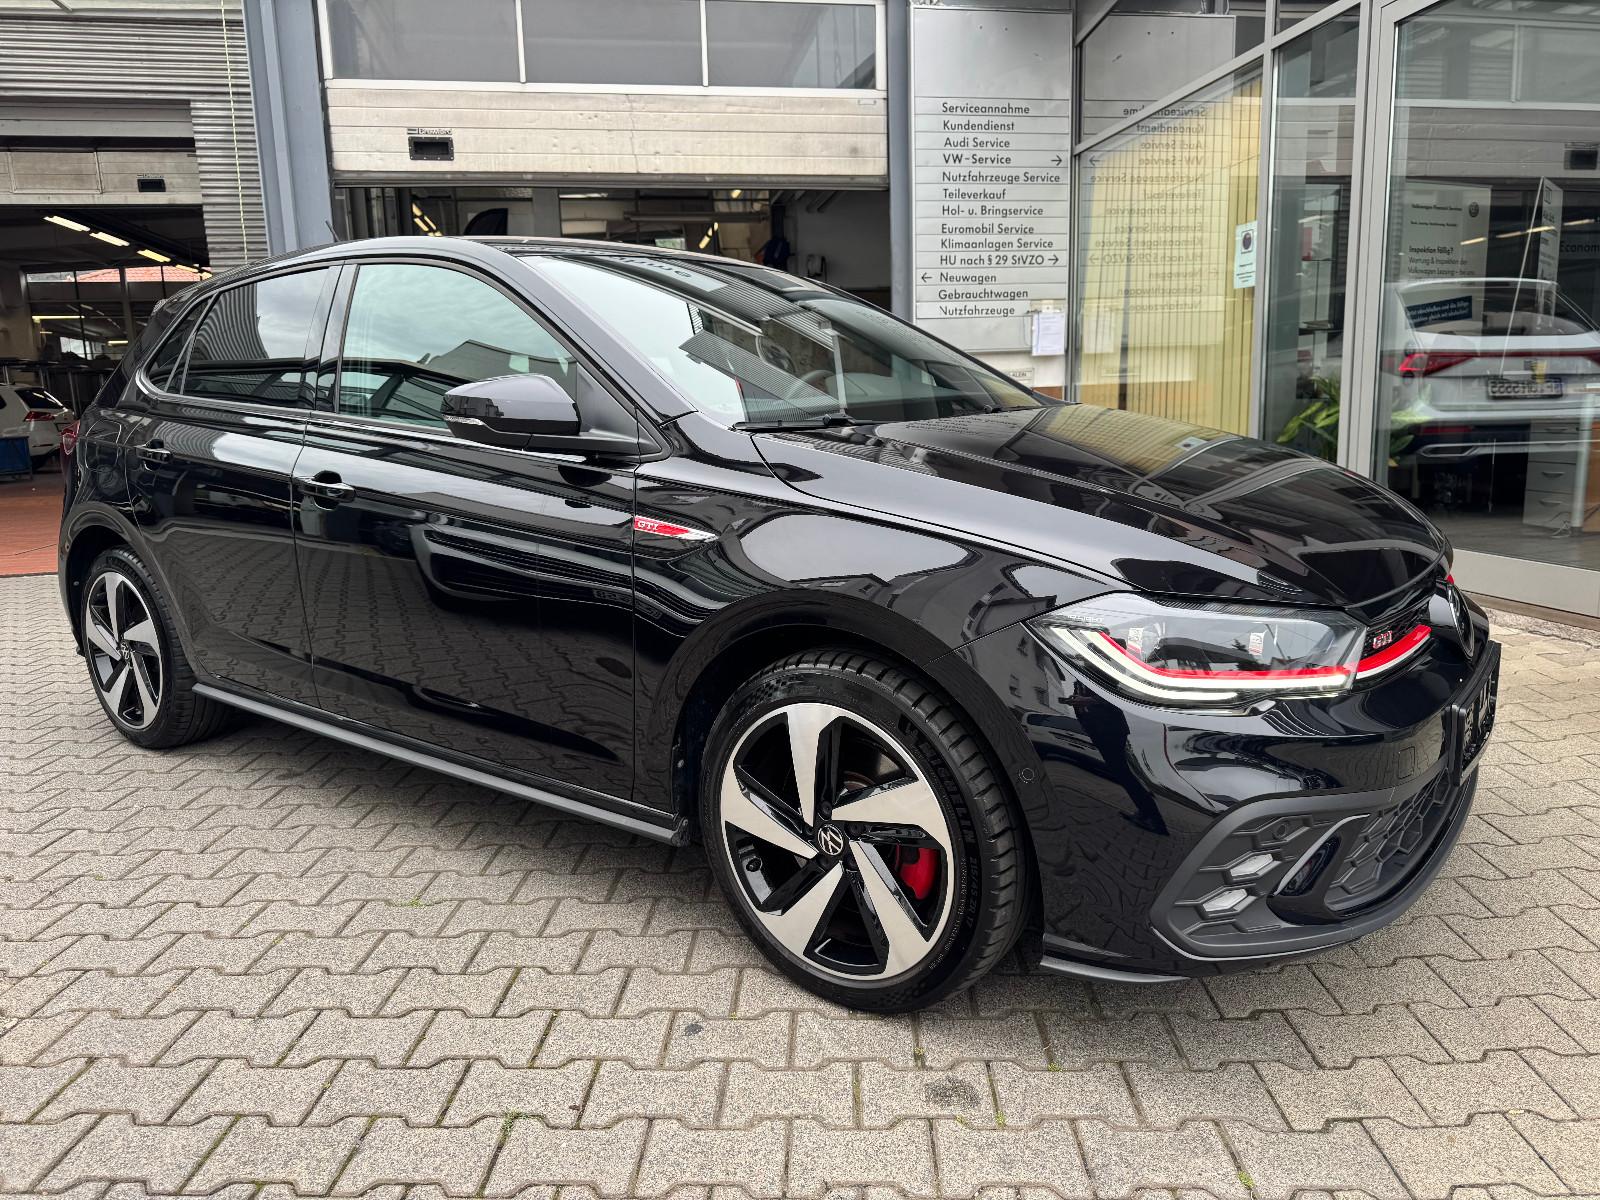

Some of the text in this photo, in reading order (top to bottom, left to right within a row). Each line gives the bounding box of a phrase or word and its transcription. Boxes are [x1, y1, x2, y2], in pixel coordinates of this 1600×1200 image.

[942, 103, 1030, 114] Serviceannahme
[943, 120, 1014, 131] Kundendienst
[944, 137, 1010, 148] Audi Service
[943, 154, 1011, 164] VW-Service
[942, 172, 1060, 184] Nutzfahrzeuge Service
[943, 189, 1006, 200] Teileverkauf
[942, 205, 1044, 218] Hol- u. Bringservice
[941, 223, 1034, 234] Euromobil Service
[940, 238, 1054, 251] Klimaanlagen Service
[940, 254, 1044, 266] HU nach § 29 StVZO
[939, 272, 997, 284] Neuwagen
[938, 289, 1029, 300] Gebrauchtwagen
[939, 305, 1015, 317] Nutzfahrzeuge
[637, 520, 658, 530] GTI
[1373, 630, 1393, 649] GTI
